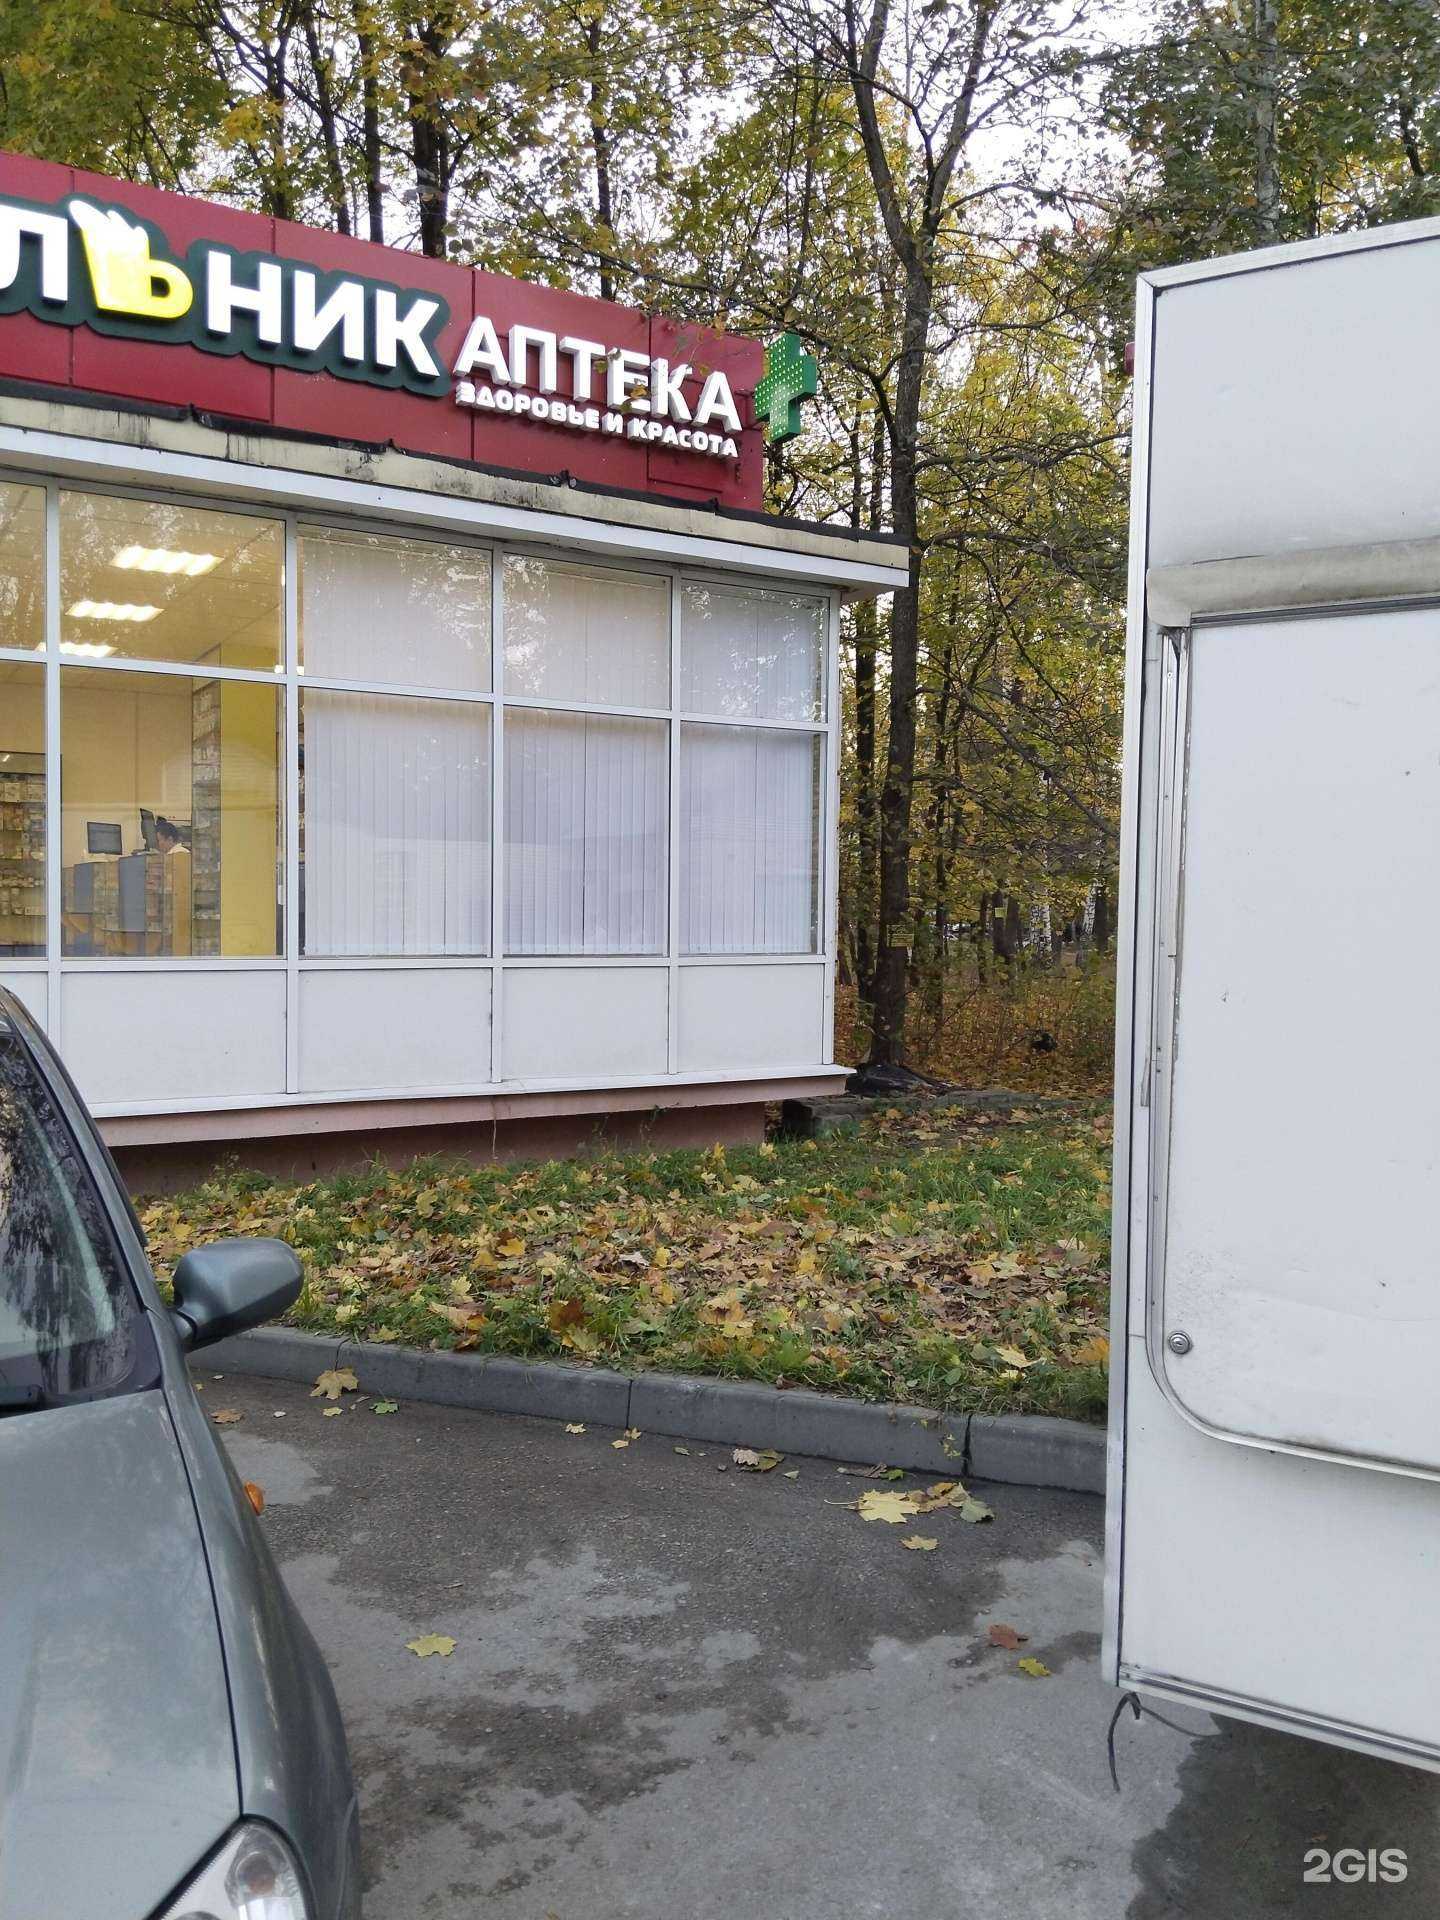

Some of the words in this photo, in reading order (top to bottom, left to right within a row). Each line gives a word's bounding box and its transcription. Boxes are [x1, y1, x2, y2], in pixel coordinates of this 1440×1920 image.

[454, 315, 742, 432] АПТЕКА
[455, 380, 601, 430] ЗДОРОВЬЕ
[602, 411, 624, 434] И
[628, 417, 739, 458] КРАСОТА
